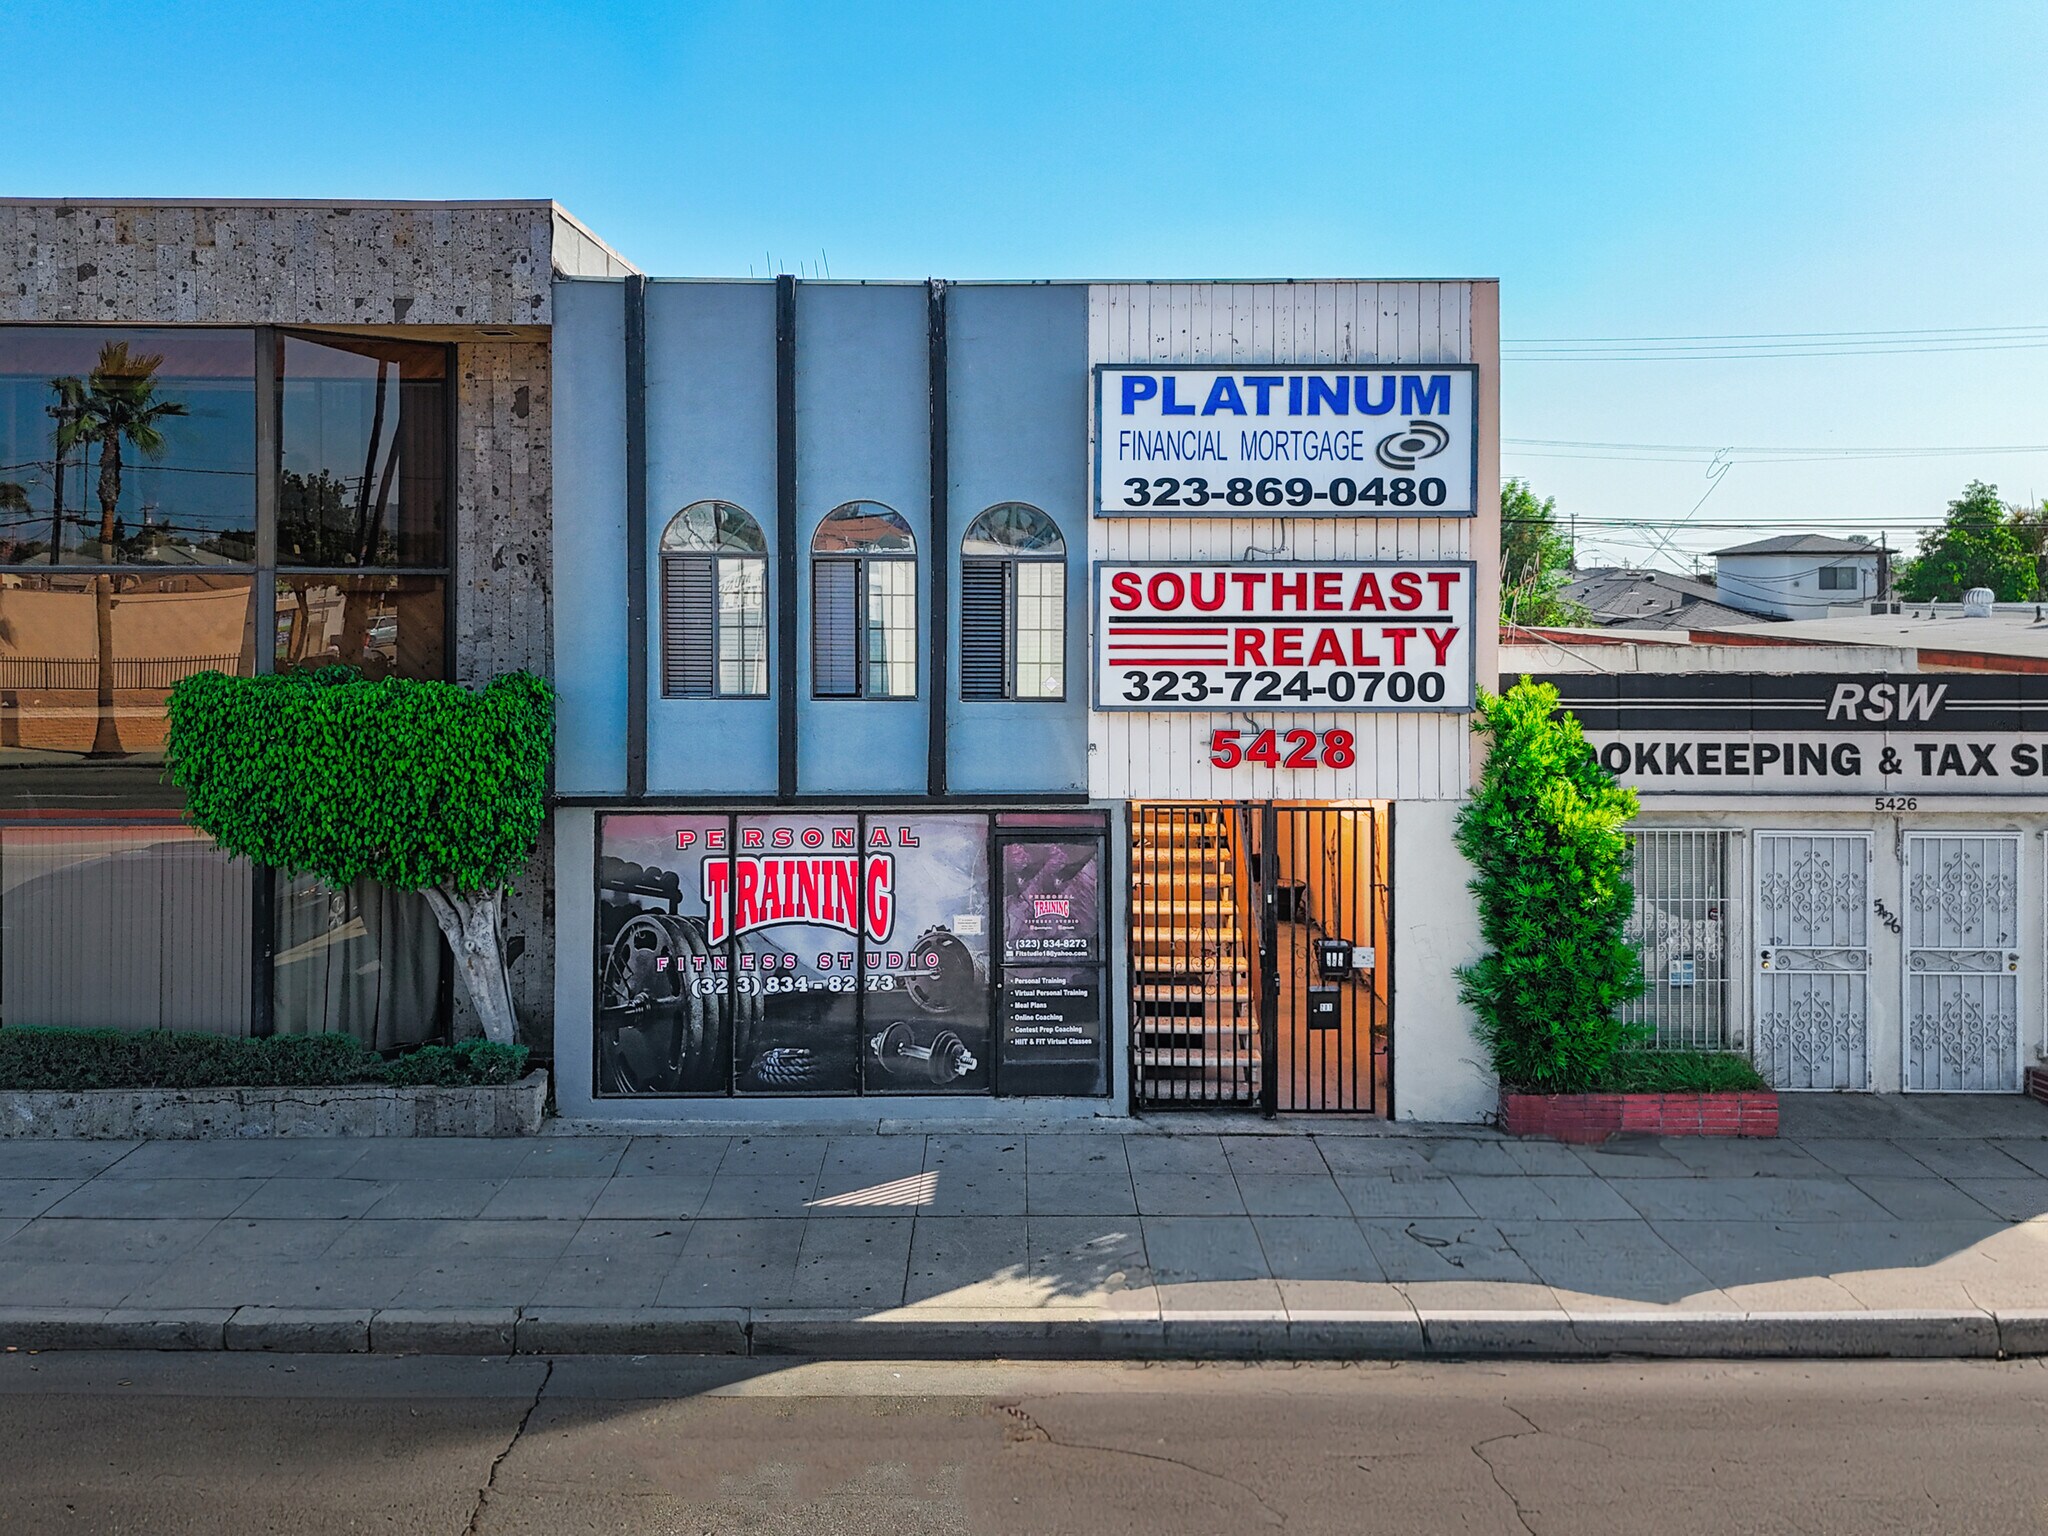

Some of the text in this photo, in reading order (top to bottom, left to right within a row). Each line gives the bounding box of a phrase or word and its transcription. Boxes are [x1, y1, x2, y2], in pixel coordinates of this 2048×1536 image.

[1121, 375, 1452, 416] PLATINUM
[1119, 430, 1364, 461] FINANCIAL MORTGAGE
[1123, 477, 1448, 507] 323-869-0480
[1109, 571, 1461, 612] SOUTHEAST
[1233, 627, 1461, 667] REALTY
[1122, 670, 1446, 703] 323-724-0700
[1826, 683, 1948, 722] RSW
[1210, 728, 1356, 770] 5428
[1878, 746, 1902, 776] &
[1914, 743, 1999, 776] TAX
[1875, 797, 1917, 811] 5426
[676, 826, 920, 850] PERSONAL
[704, 854, 894, 945] TRAINING
[1034, 900, 1069, 918] TRAINING
[1015, 939, 1087, 949] (323) 834-8273
[656, 951, 940, 973] FITNESS STUDIO
[690, 976, 761, 999] (323)
[1042, 977, 1067, 985] Training
[1064, 989, 1088, 997] Training
[1039, 1026, 1054, 1034] Prep
[1054, 1026, 1083, 1034] Coaching
